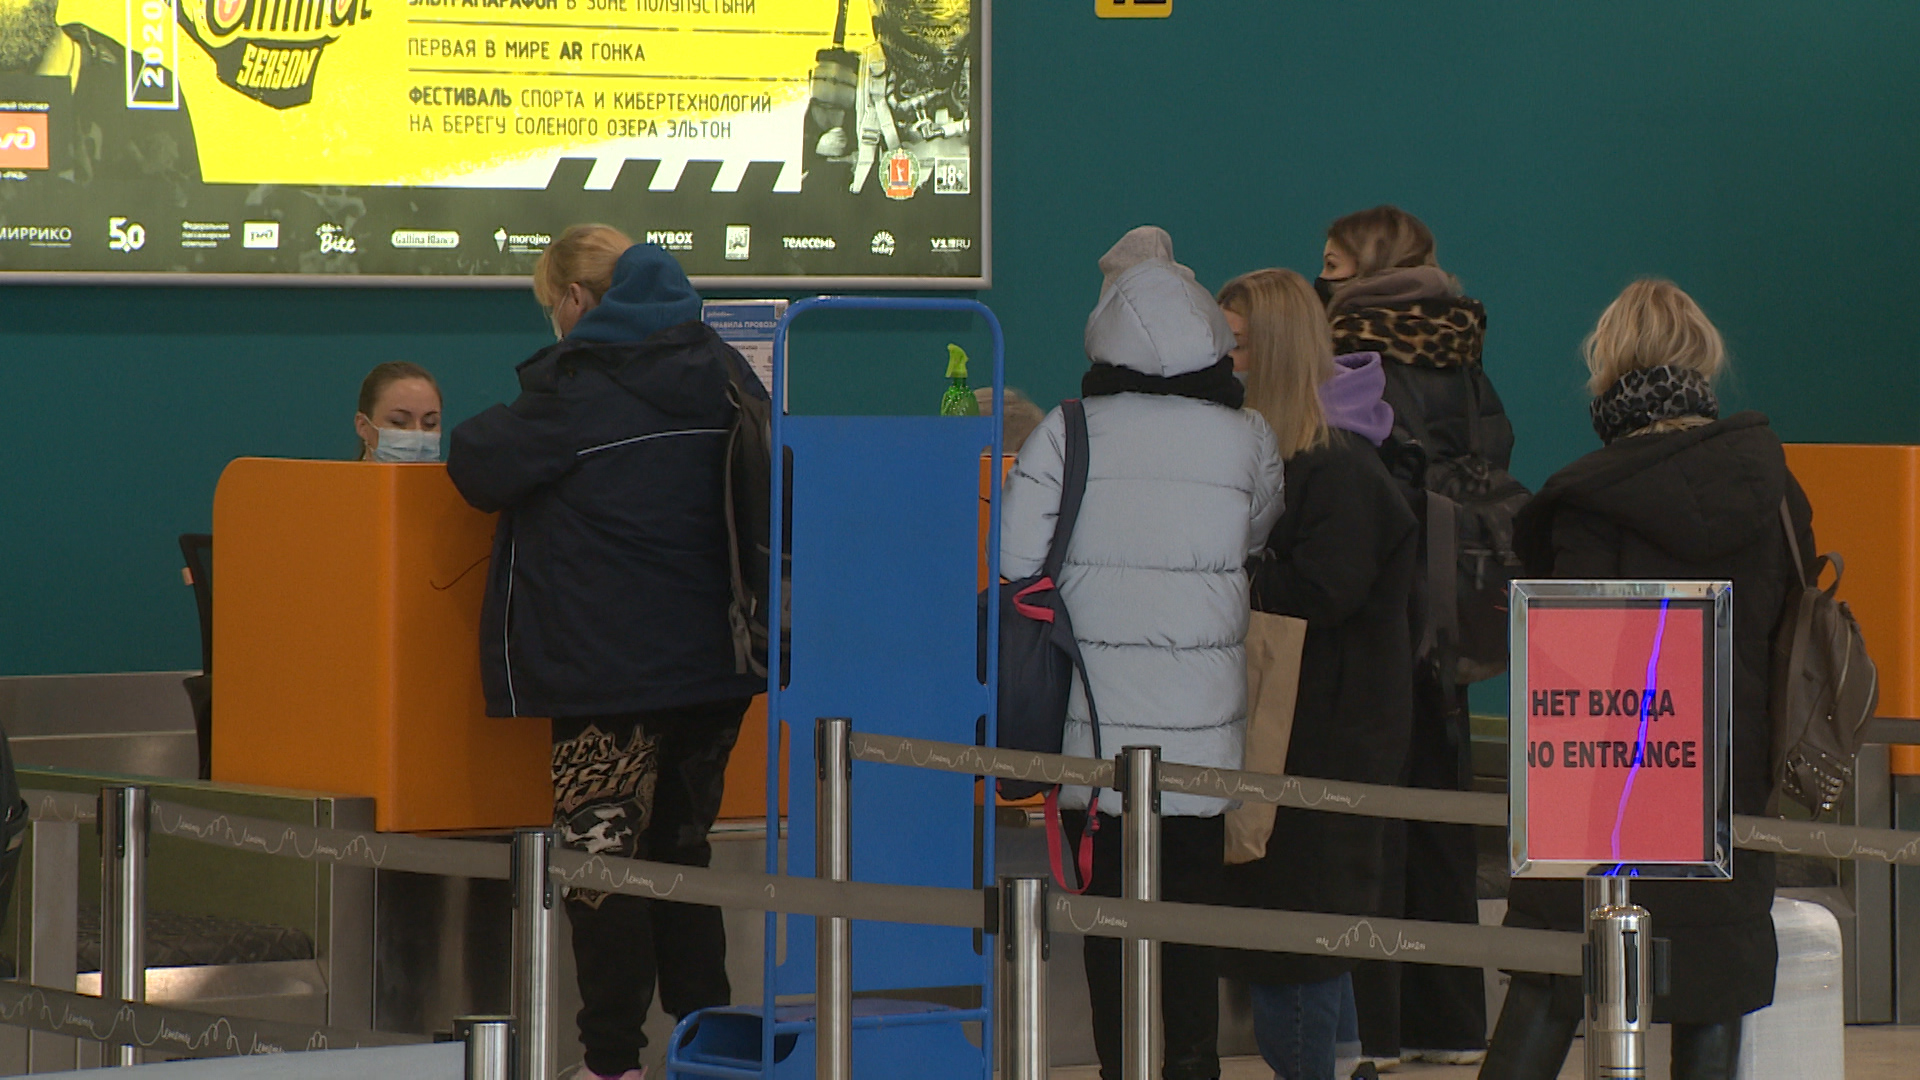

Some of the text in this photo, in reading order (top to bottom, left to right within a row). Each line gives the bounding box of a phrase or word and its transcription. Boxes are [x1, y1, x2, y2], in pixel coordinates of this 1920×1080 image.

[142, 1, 165, 88] 2020
[407, 37, 646, 61] ПЕРВАЯ В МИРЕ AR ГОНКА
[236, 43, 320, 89] SEASON
[408, 86, 772, 112] ФЕСТИВАЛЬ СПОРТА И КИБЕРТЕХНОЛОГИЙ
[409, 114, 732, 138] НА БЕРЕГУ СОЛЕНОГО ОЗЕРА ЭЛЬТОН
[942, 165, 965, 186] 18+
[320, 232, 357, 254] Bite
[396, 234, 454, 244] Gallina Blanca
[646, 231, 693, 245] MYBOX
[1532, 689, 1675, 722] НЕТ ВХОДА
[1563, 741, 1696, 768] ENTRANCE
